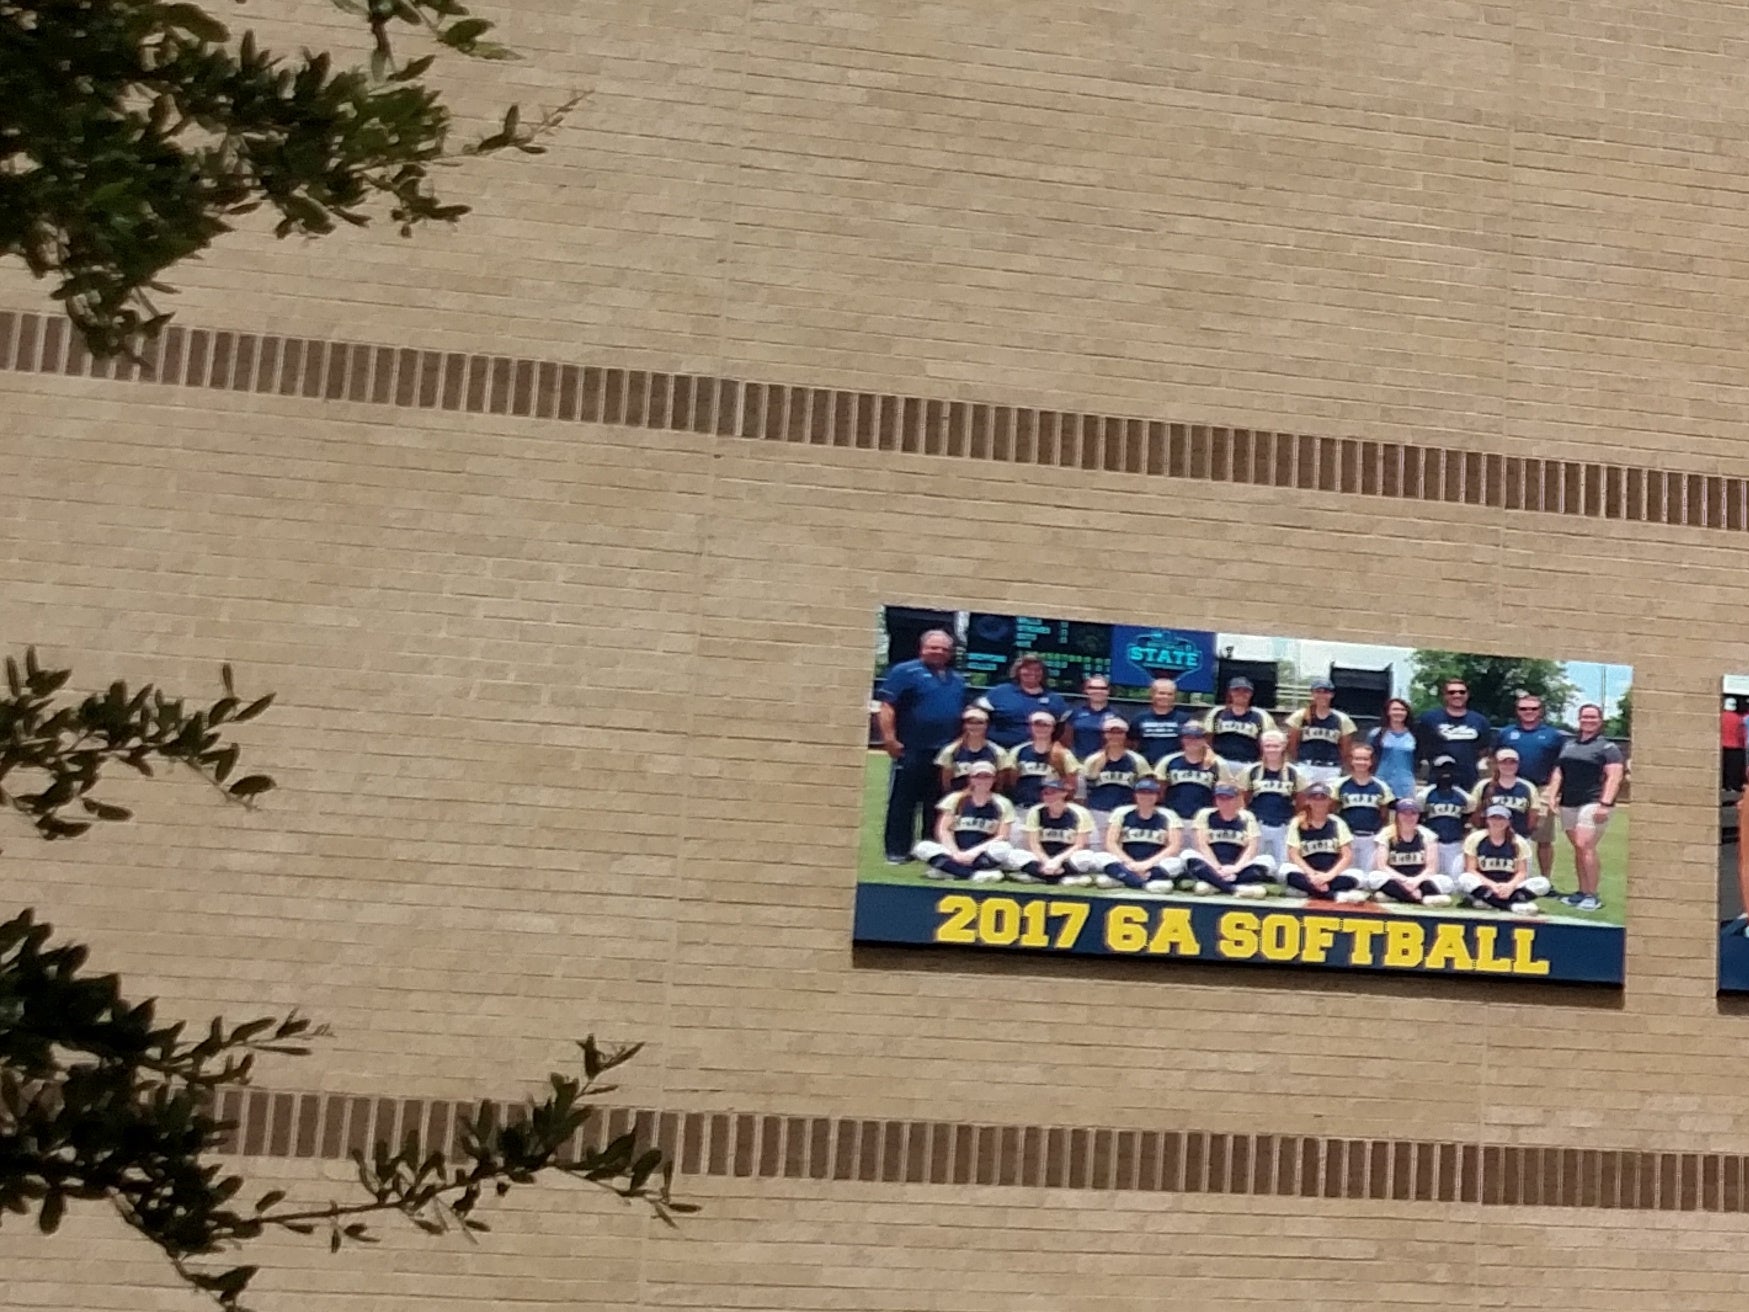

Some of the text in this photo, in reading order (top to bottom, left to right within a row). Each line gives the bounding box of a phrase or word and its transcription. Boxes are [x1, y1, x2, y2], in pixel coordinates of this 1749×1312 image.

[936, 895, 1549, 975] 2017 6A SOFTBALL
